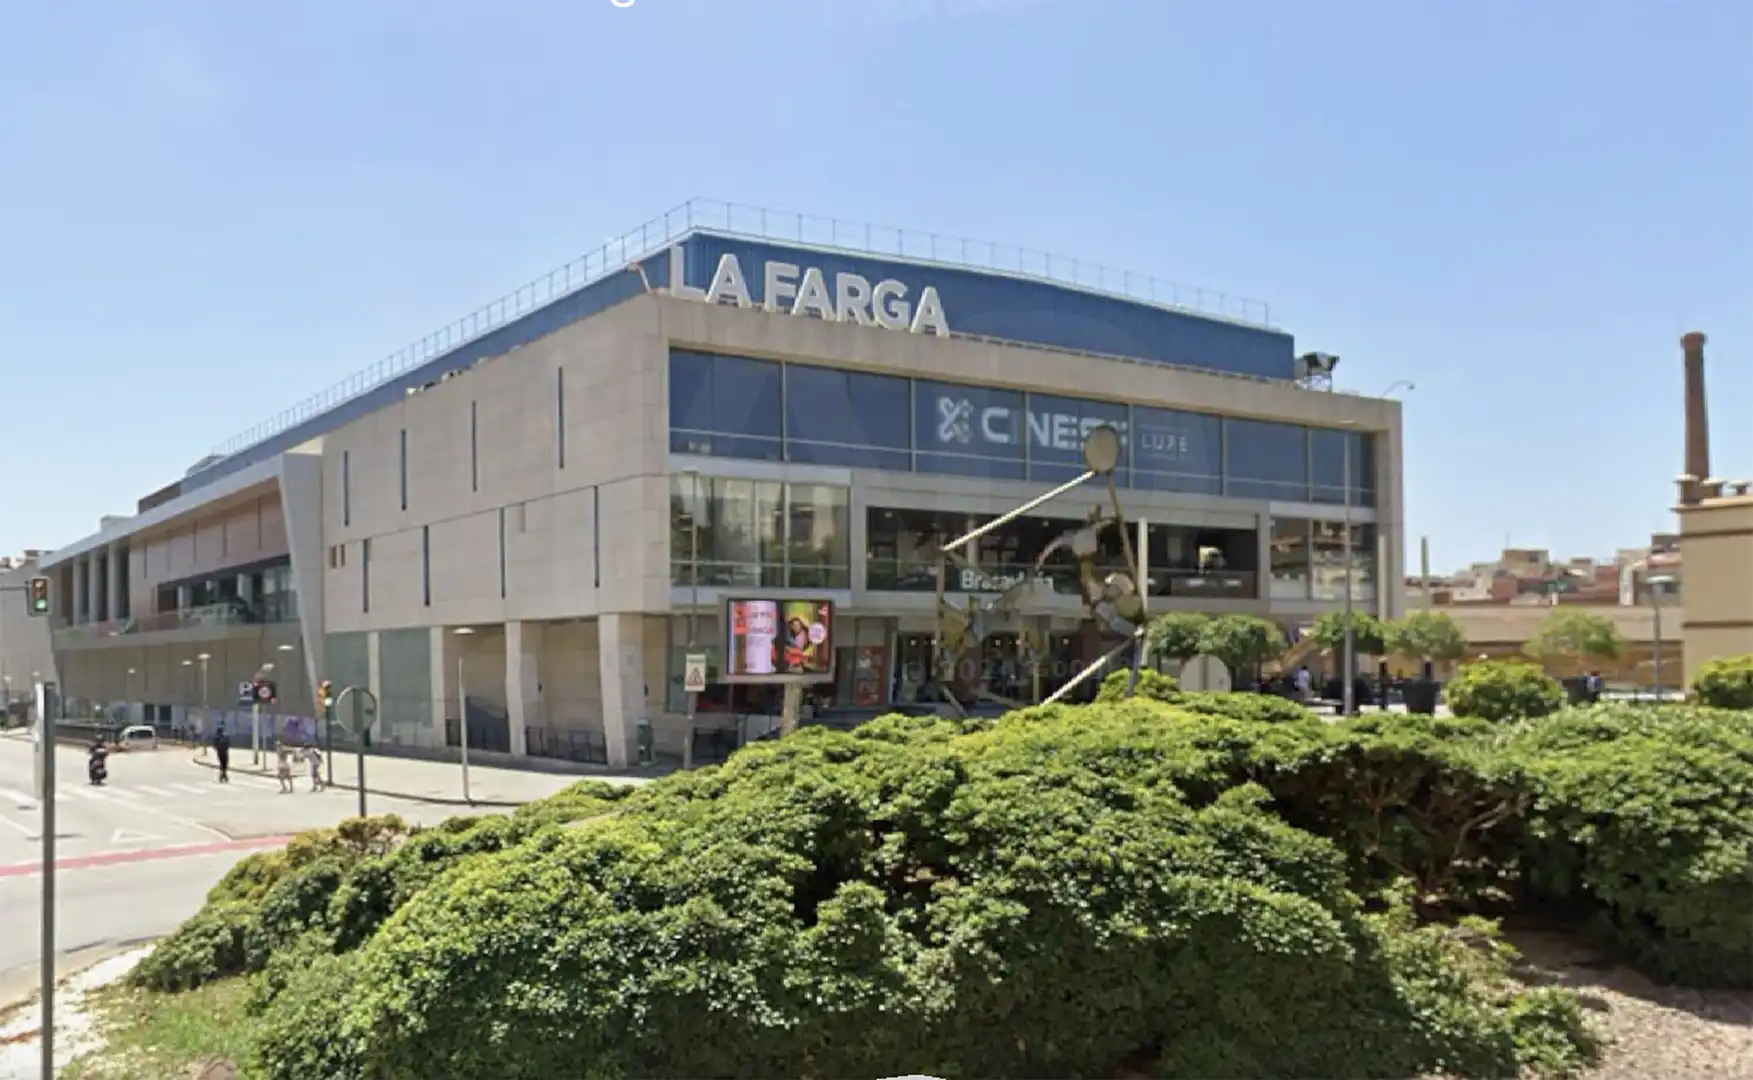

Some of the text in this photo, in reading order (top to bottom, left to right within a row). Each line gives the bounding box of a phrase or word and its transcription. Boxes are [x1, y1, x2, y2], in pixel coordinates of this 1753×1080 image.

[670, 244, 950, 337] LA FARGA
[981, 406, 1128, 450] CINES
